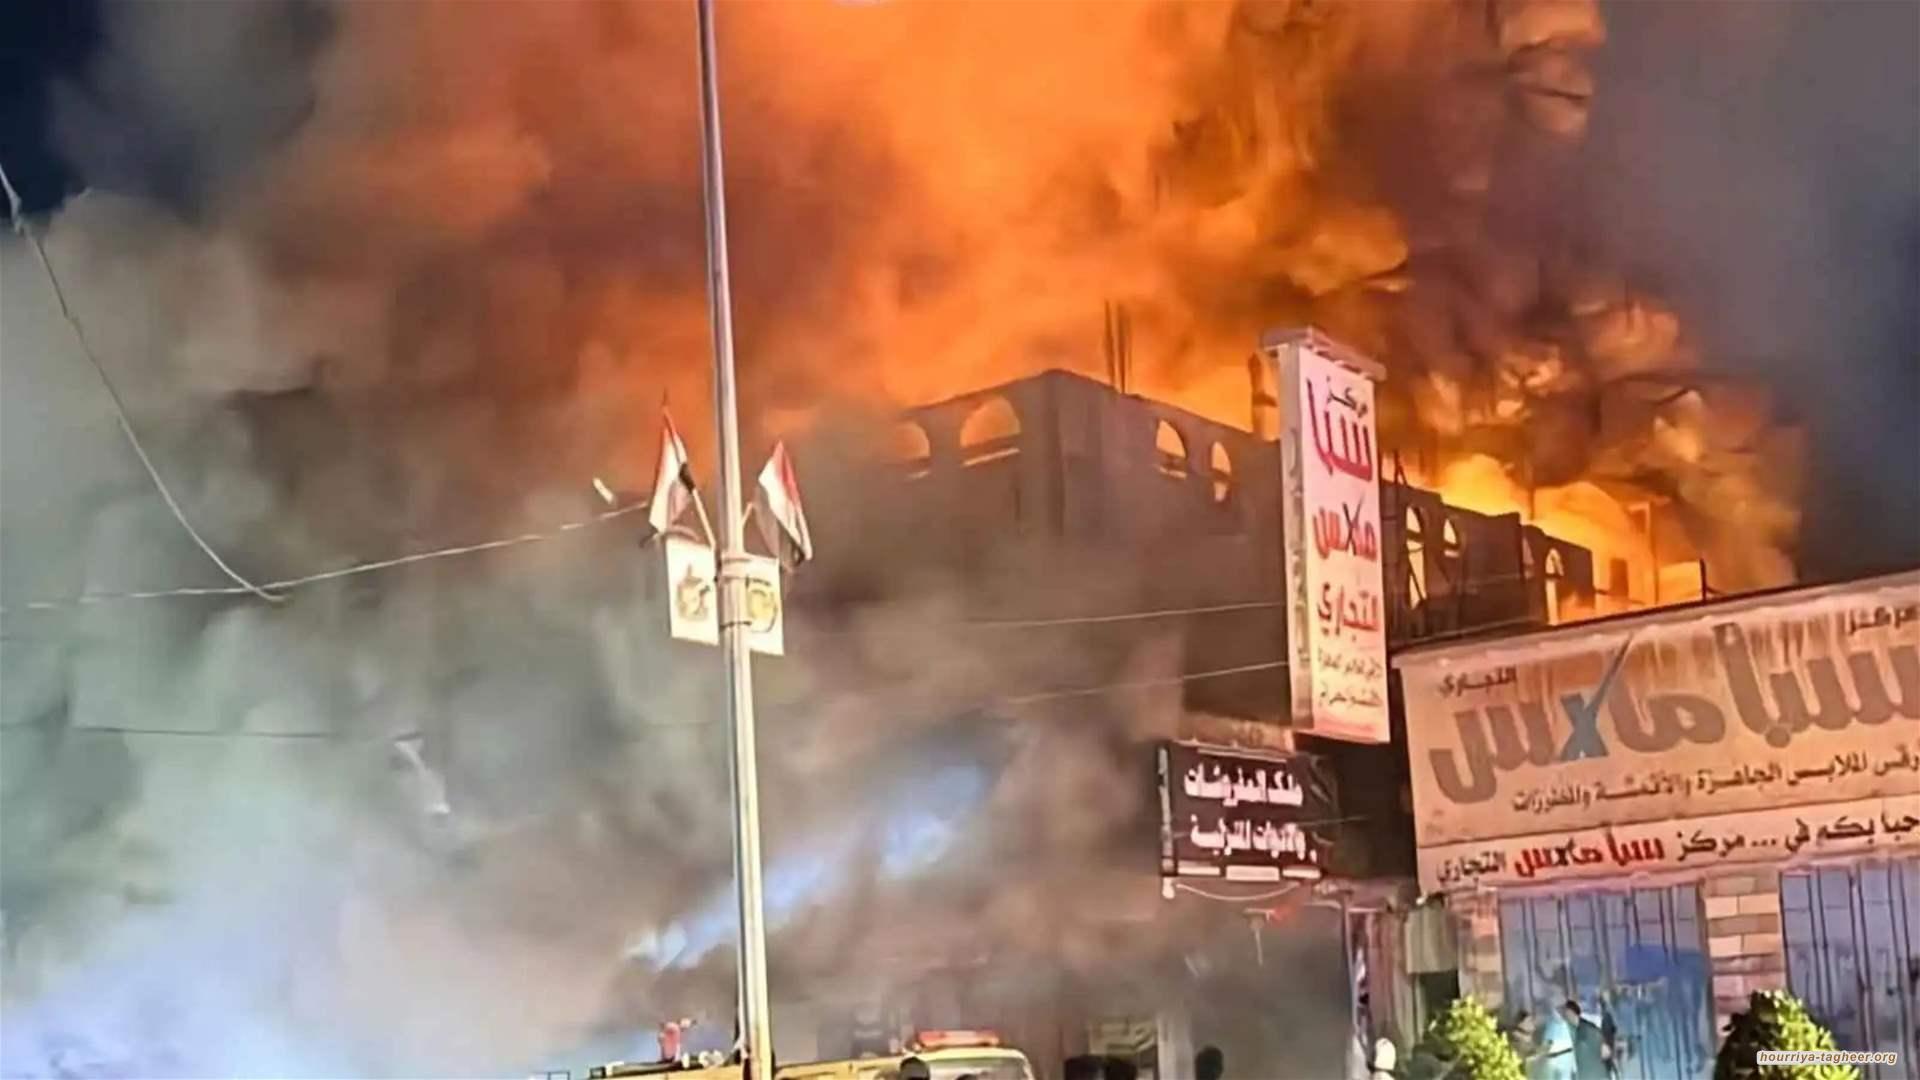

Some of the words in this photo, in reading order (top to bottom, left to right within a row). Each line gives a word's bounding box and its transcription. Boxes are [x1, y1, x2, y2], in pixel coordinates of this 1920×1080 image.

[1439, 665, 1517, 697] التجاري
[1696, 761, 1782, 795] الجاهزة
[1786, 751, 1868, 787] الملابس
[1676, 830, 1745, 863] مركز
[1436, 850, 1507, 883] التجاري
